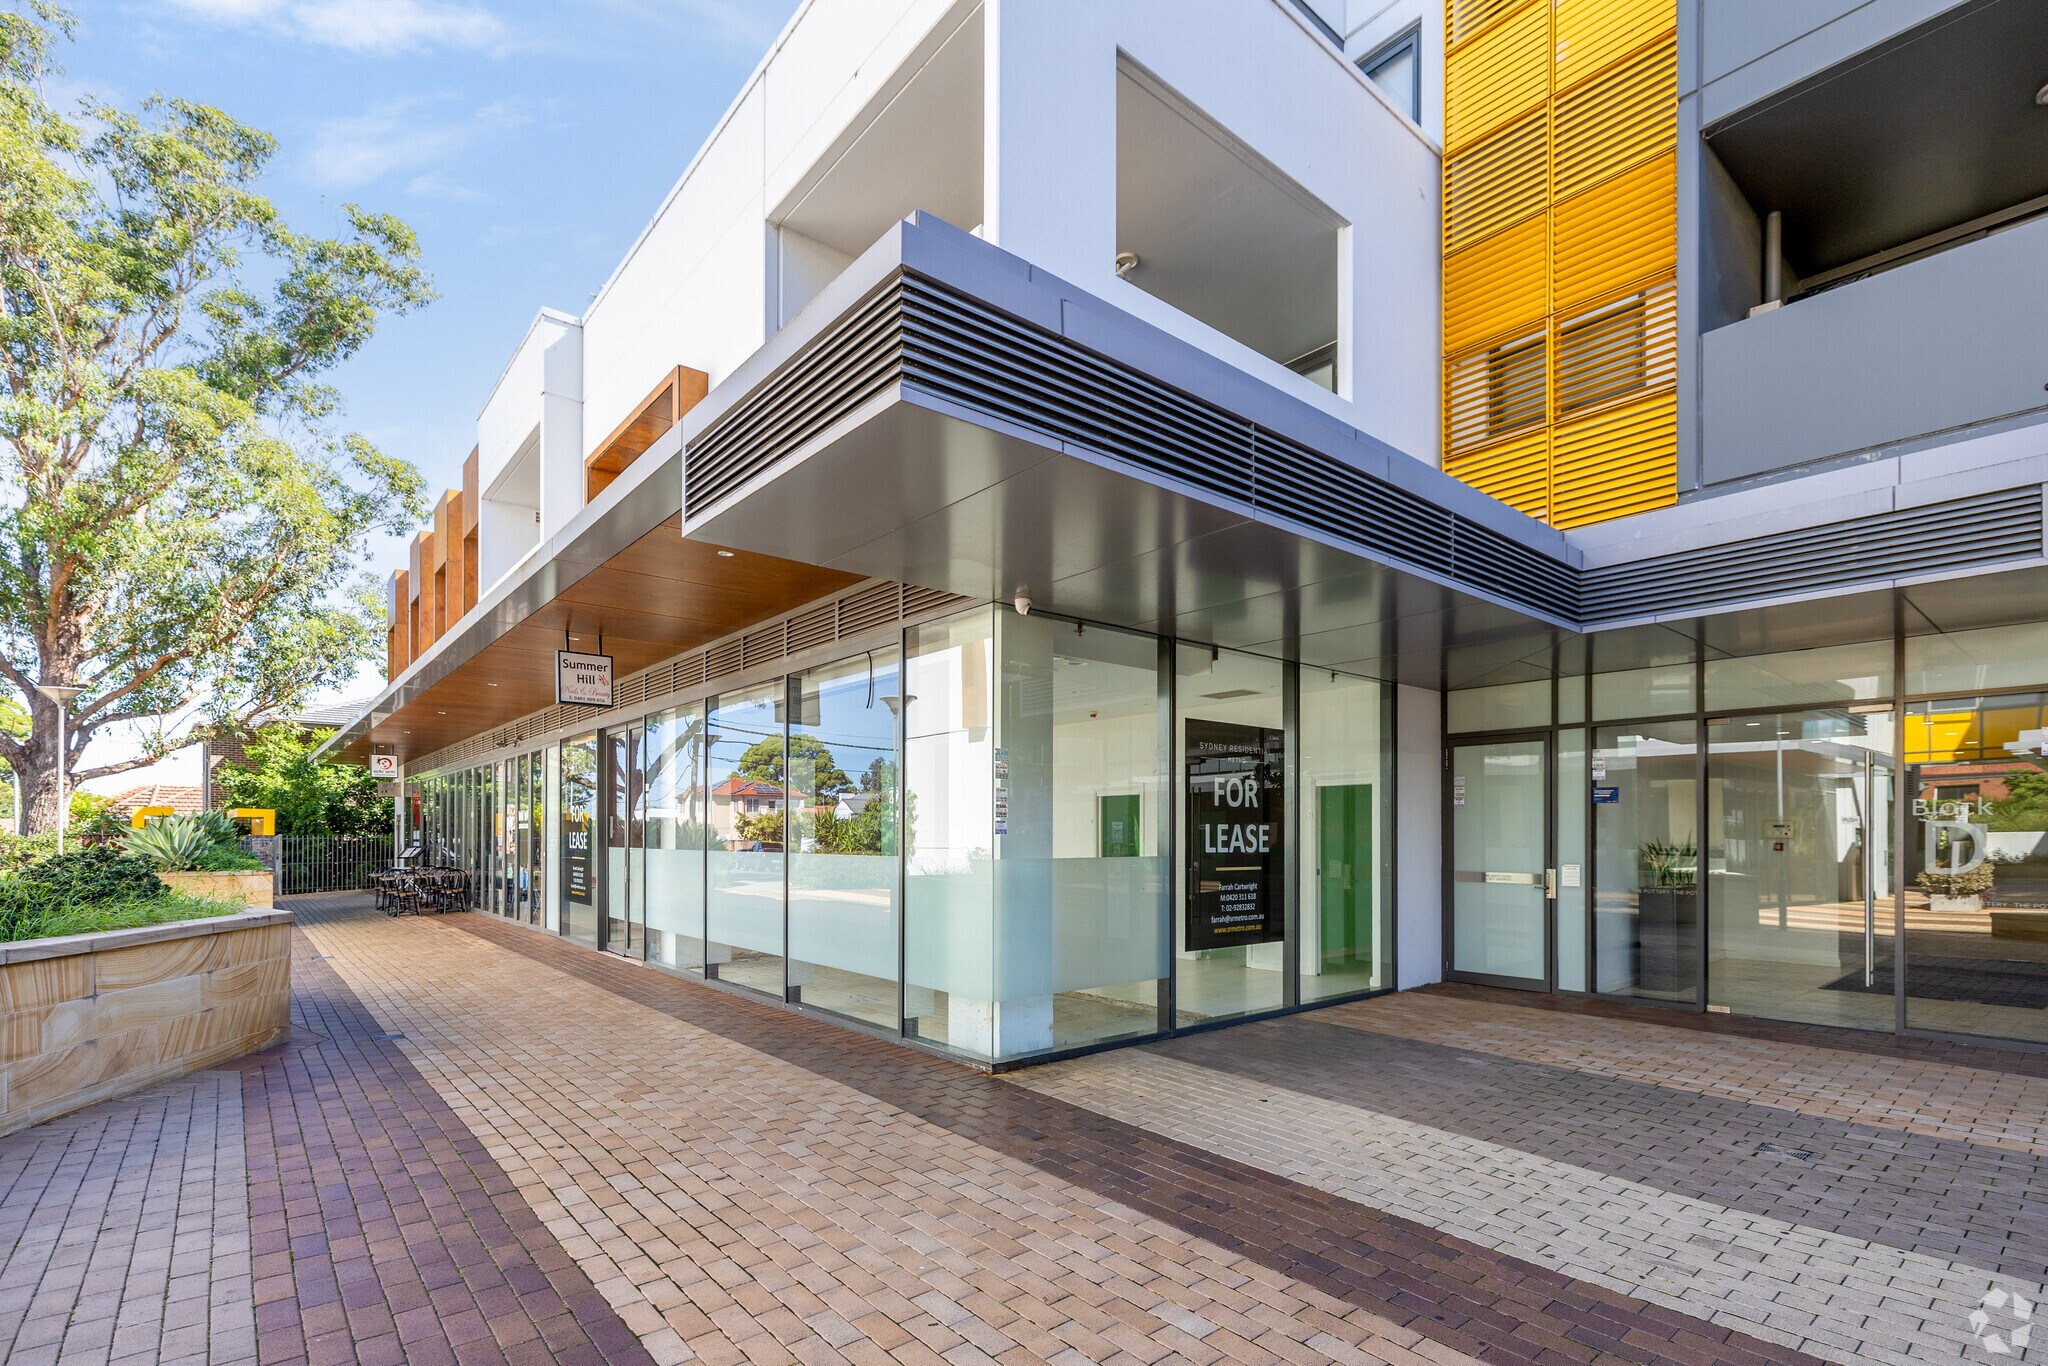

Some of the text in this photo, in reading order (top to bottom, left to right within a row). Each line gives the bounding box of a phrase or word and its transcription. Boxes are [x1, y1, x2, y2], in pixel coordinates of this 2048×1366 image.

[563, 659, 608, 672] Summer
[577, 674, 595, 685] Hill
[1199, 741, 1272, 756] SYDNEY RESIDENTIAL
[1213, 777, 1259, 808] FOR
[572, 806, 584, 822] FOR
[1912, 796, 1993, 816] Block
[569, 832, 587, 849] LEASE
[1204, 823, 1270, 854] LEASE
[1925, 820, 1986, 874] D
[1218, 882, 1258, 891] Farrah Cartwright
